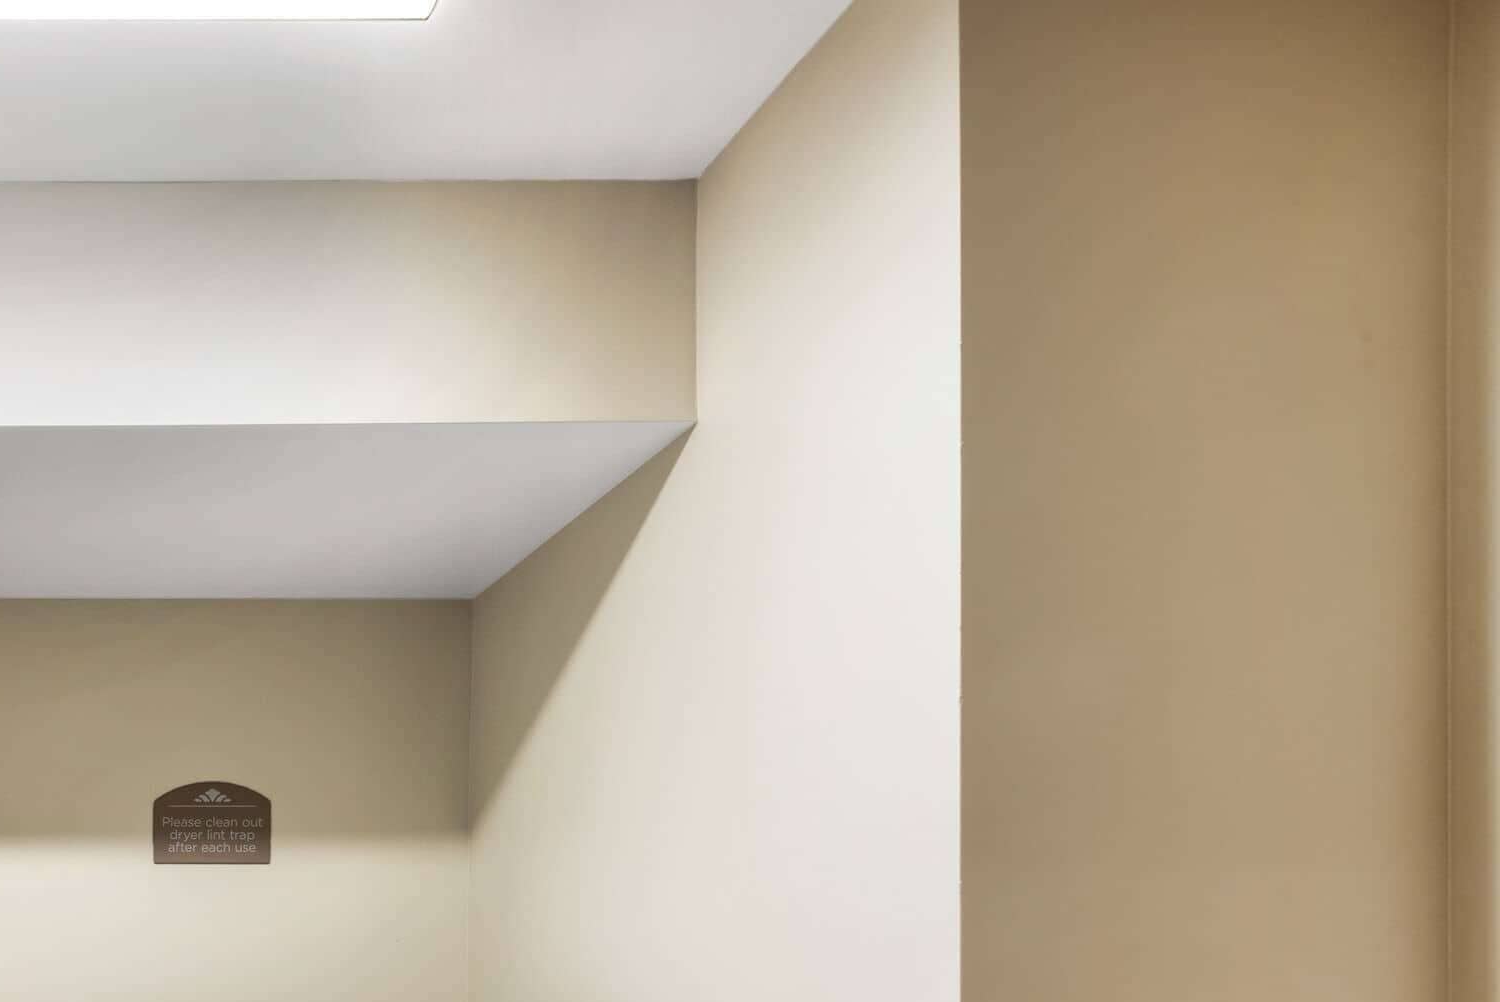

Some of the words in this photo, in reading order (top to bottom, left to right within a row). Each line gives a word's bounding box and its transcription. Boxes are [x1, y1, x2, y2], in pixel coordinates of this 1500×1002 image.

[162, 816, 202, 828] Please
[205, 816, 238, 828] clean
[242, 817, 263, 828] out
[169, 829, 203, 842] dryer
[207, 829, 226, 840] lint
[229, 830, 255, 842] trap
[168, 842, 197, 853] after
[201, 842, 231, 853] each
[235, 843, 257, 853] use
